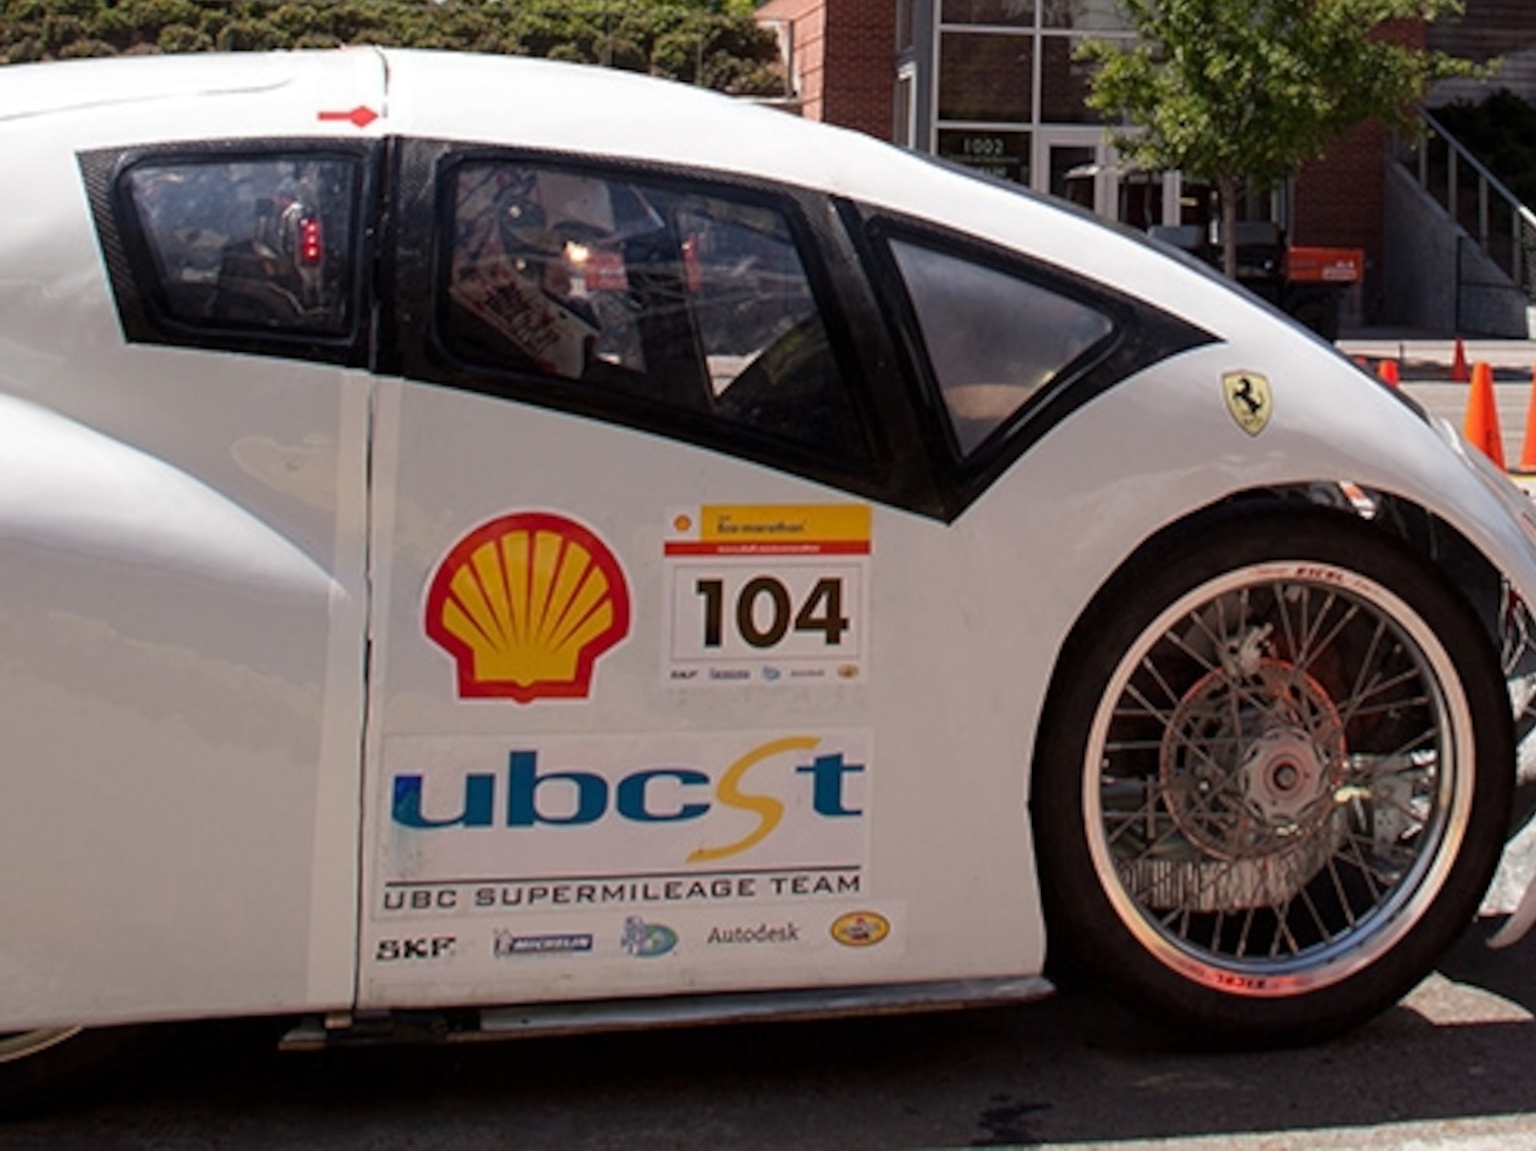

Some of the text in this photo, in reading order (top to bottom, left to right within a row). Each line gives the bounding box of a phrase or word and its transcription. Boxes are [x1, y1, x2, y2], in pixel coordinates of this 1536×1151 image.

[963, 138, 1005, 155] 1002
[696, 575, 849, 649] 104
[383, 875, 861, 910] UBC SUPERMILEAGE TEAM
[707, 923, 799, 944] Autodesk
[376, 936, 456, 960] SKF
